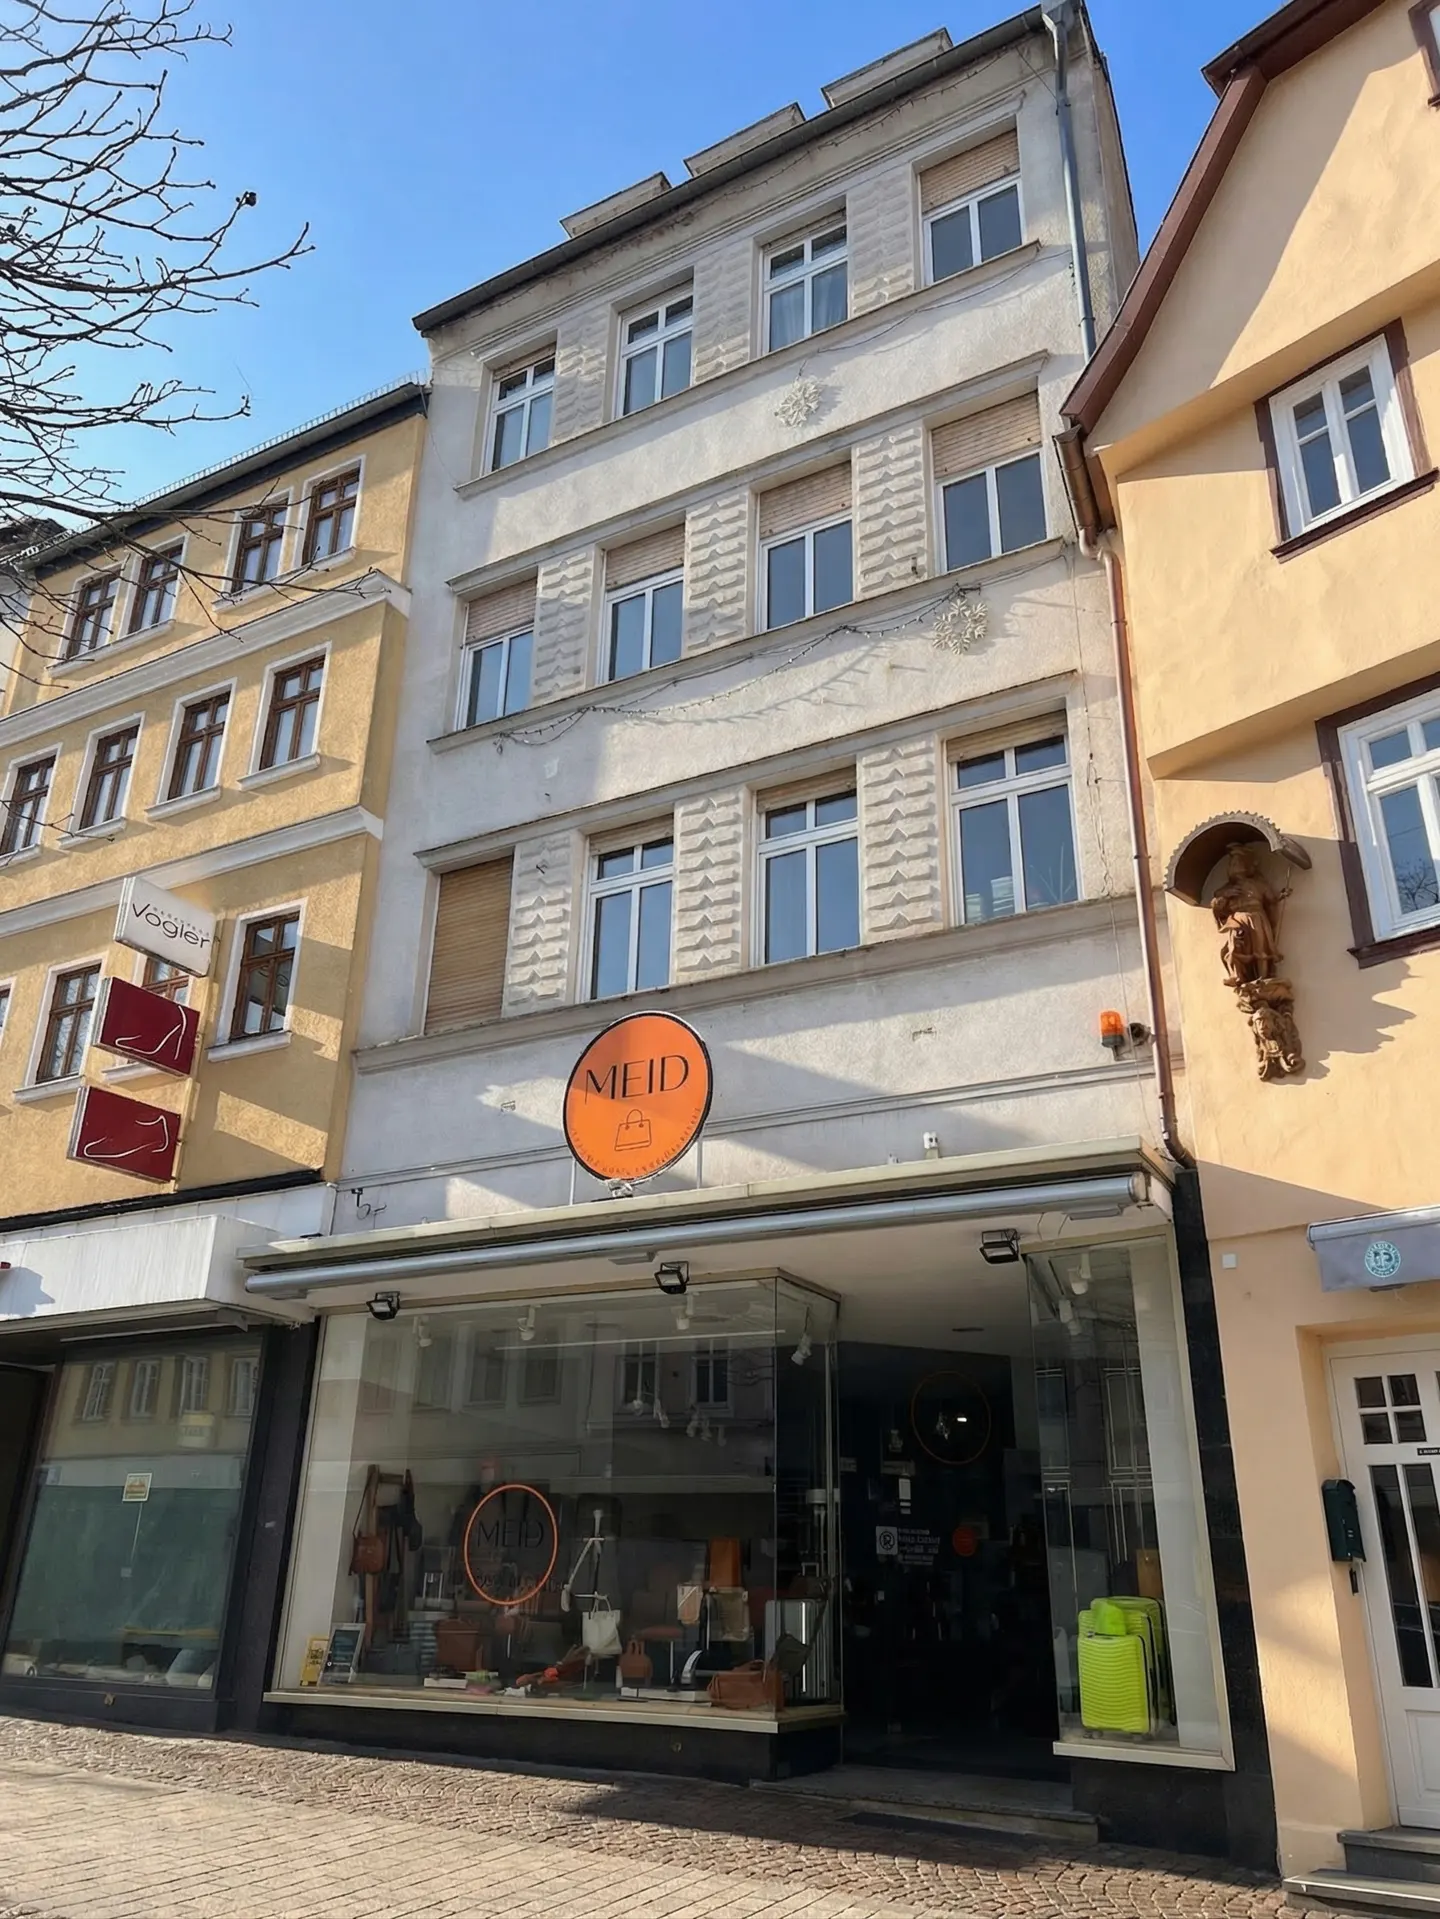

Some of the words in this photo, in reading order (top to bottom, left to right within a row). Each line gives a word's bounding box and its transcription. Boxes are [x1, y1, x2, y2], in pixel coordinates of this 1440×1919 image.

[132, 903, 210, 948] Vogler
[585, 1054, 689, 1105] MEID
[477, 1520, 545, 1549] MEID
